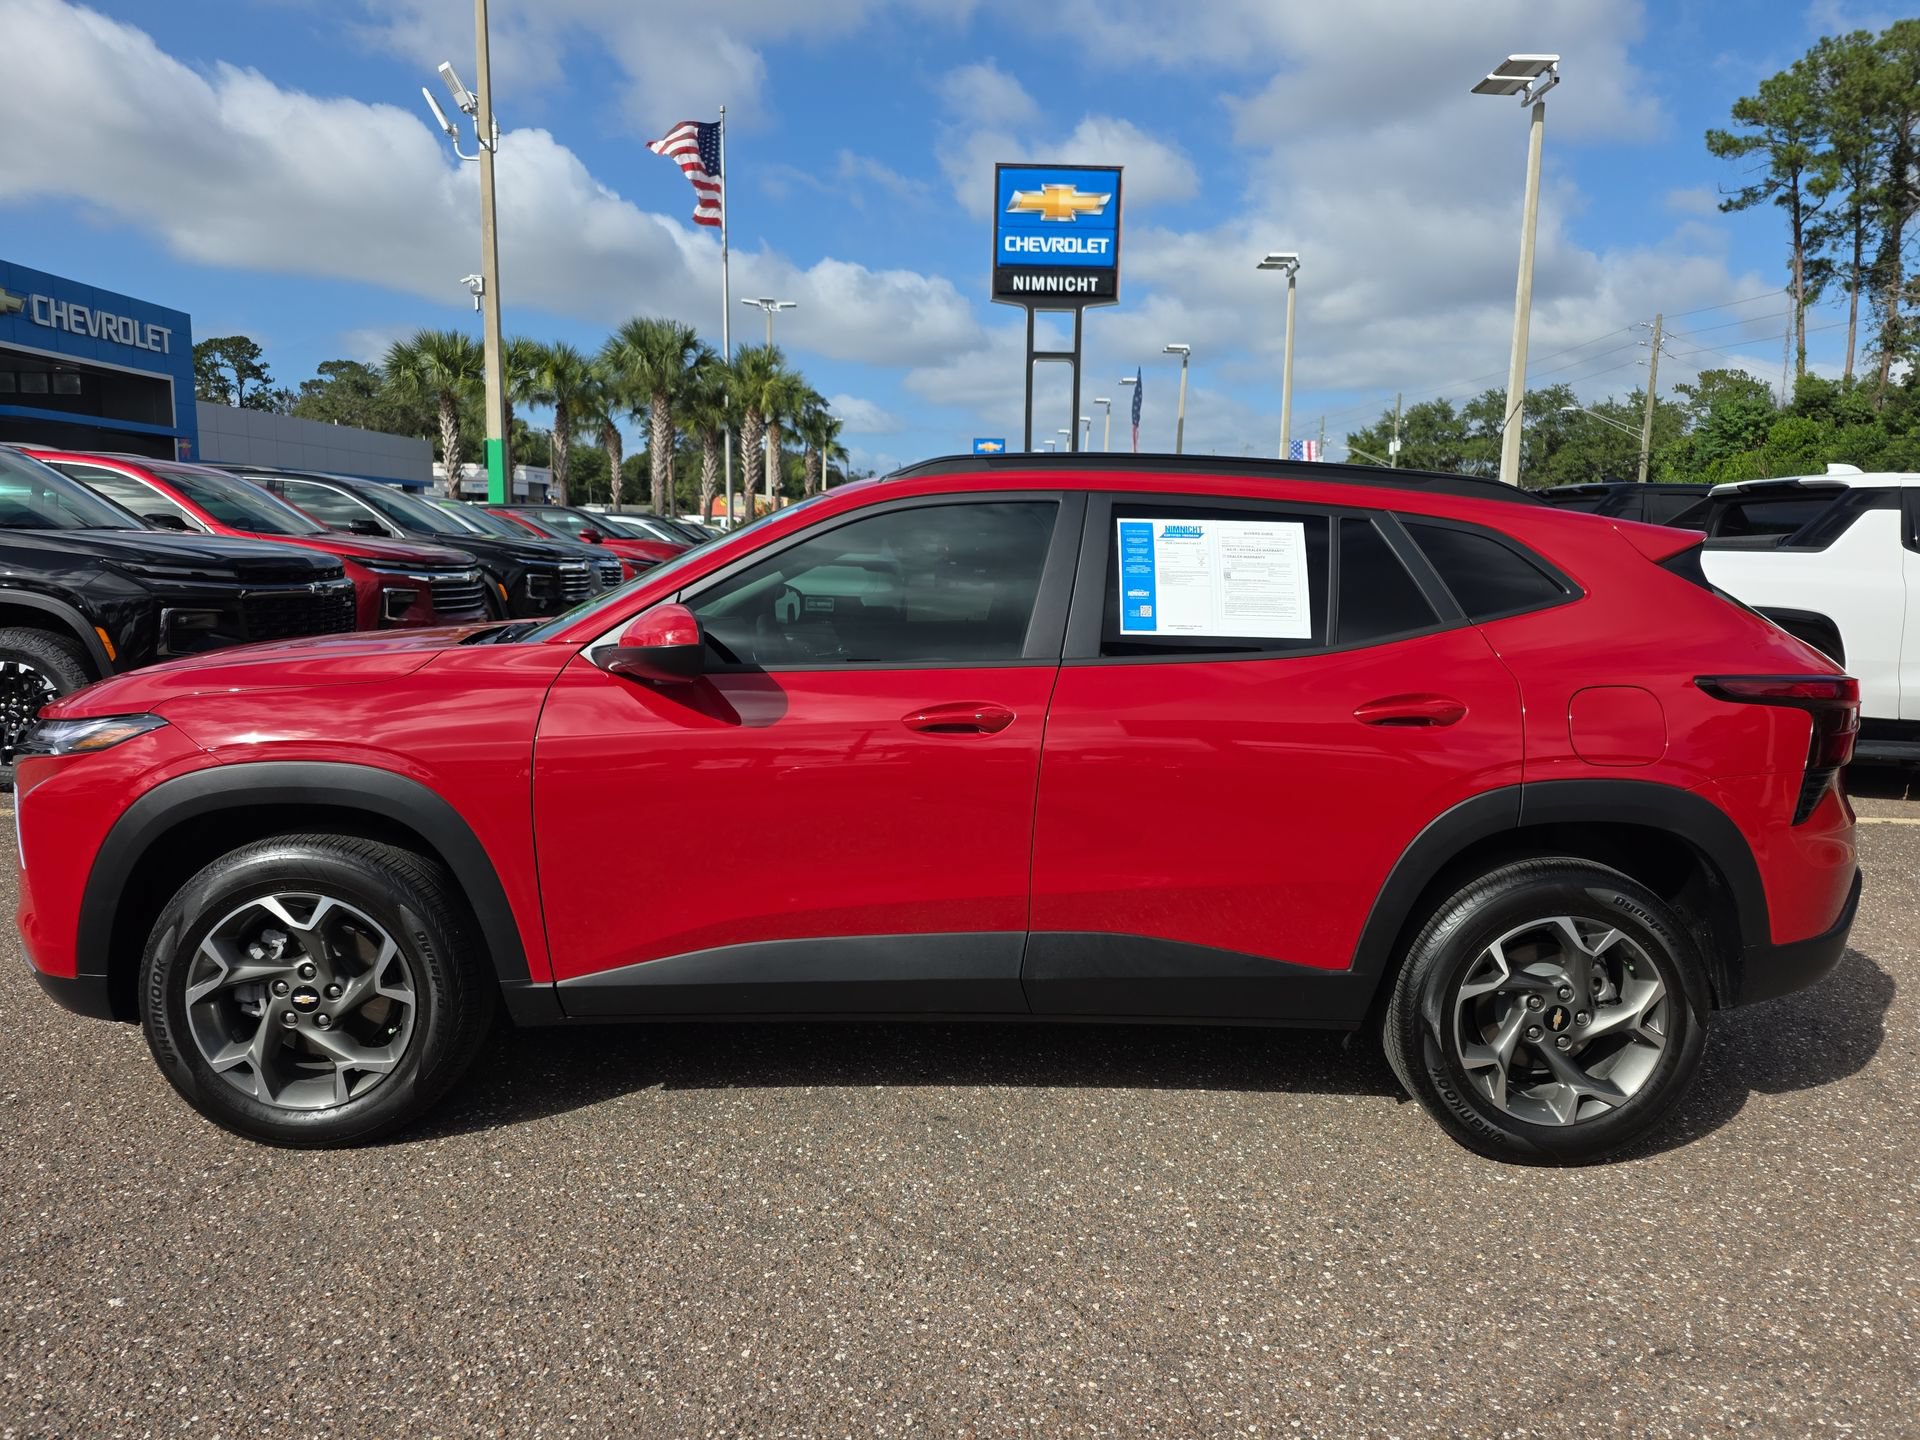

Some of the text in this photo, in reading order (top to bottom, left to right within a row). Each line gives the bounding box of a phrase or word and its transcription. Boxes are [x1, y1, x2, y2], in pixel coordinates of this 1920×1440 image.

[1004, 236, 1109, 253] CHEVROLET
[1013, 275, 1098, 292] NIMNICHT
[31, 294, 172, 354] CHEVROLET
[1165, 525, 1203, 533] NIMNICHT
